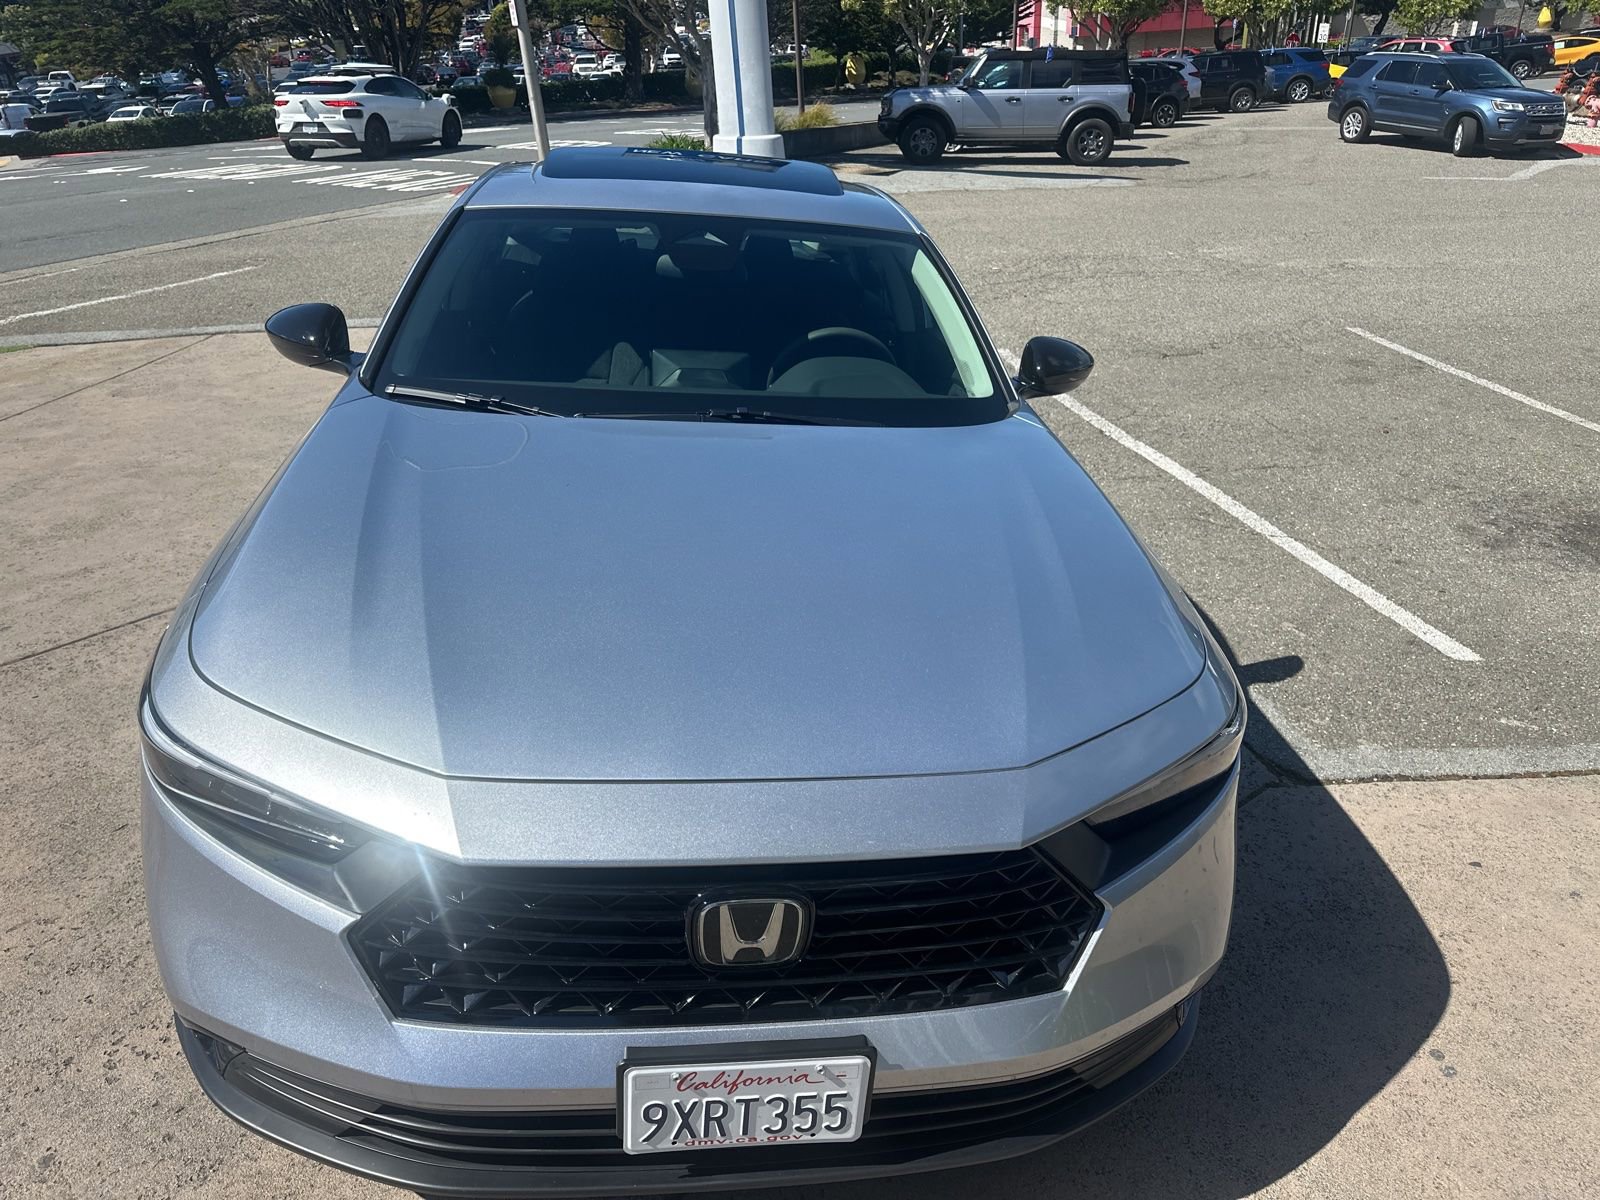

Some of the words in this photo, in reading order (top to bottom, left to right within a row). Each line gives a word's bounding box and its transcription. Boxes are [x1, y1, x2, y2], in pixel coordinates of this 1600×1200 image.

[677, 1069, 824, 1095] California
[641, 1092, 848, 1143] 9XRT355
[684, 1133, 803, 1147] dmv.ca.gov
